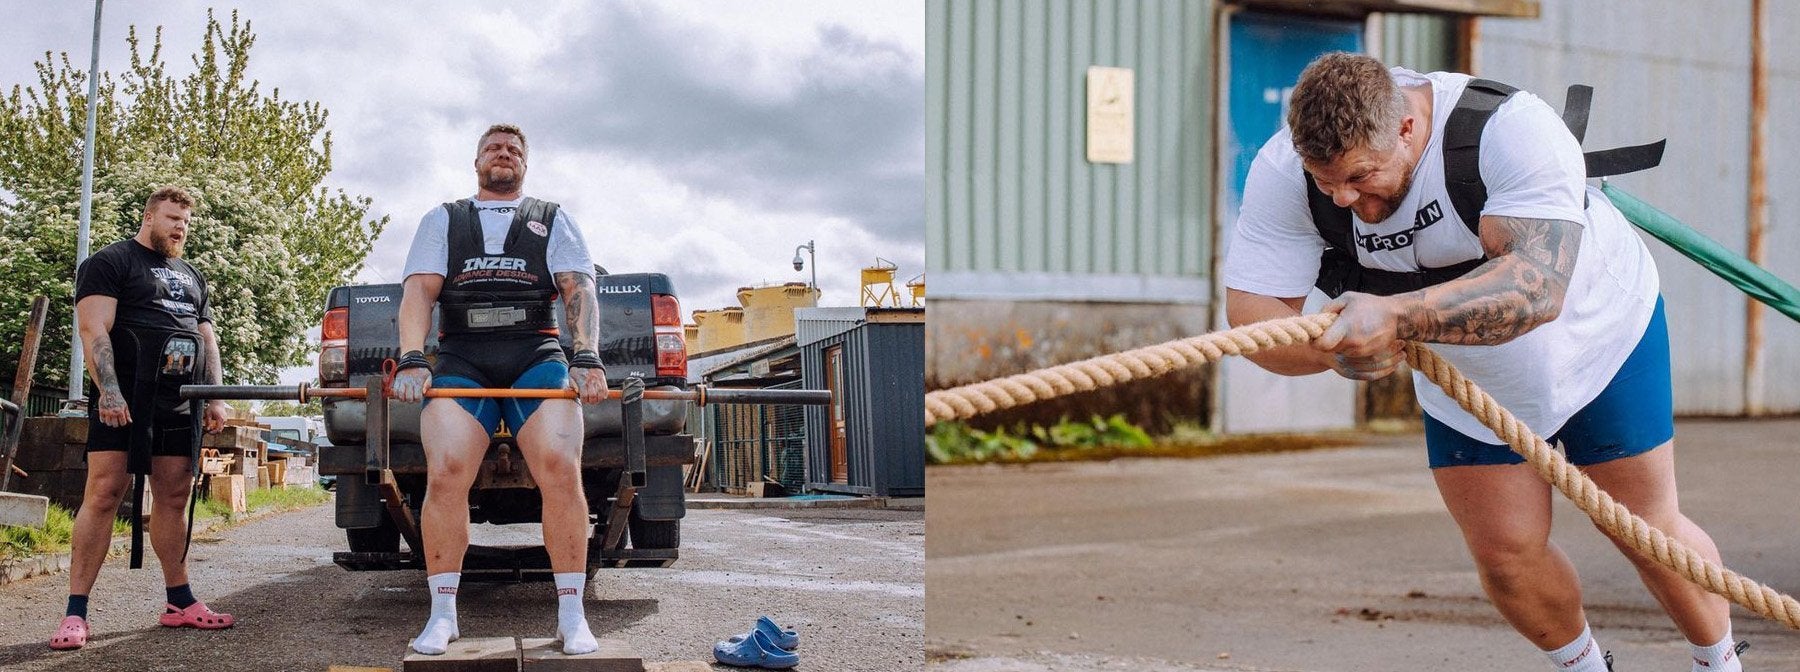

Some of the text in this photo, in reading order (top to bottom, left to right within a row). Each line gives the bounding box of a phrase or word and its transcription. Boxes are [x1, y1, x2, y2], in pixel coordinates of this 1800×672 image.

[462, 256, 527, 273] INZER
[452, 269, 539, 284] ADVANCE DESIGNS
[599, 285, 642, 294] HILUX
[355, 296, 391, 304] TOYOTA
